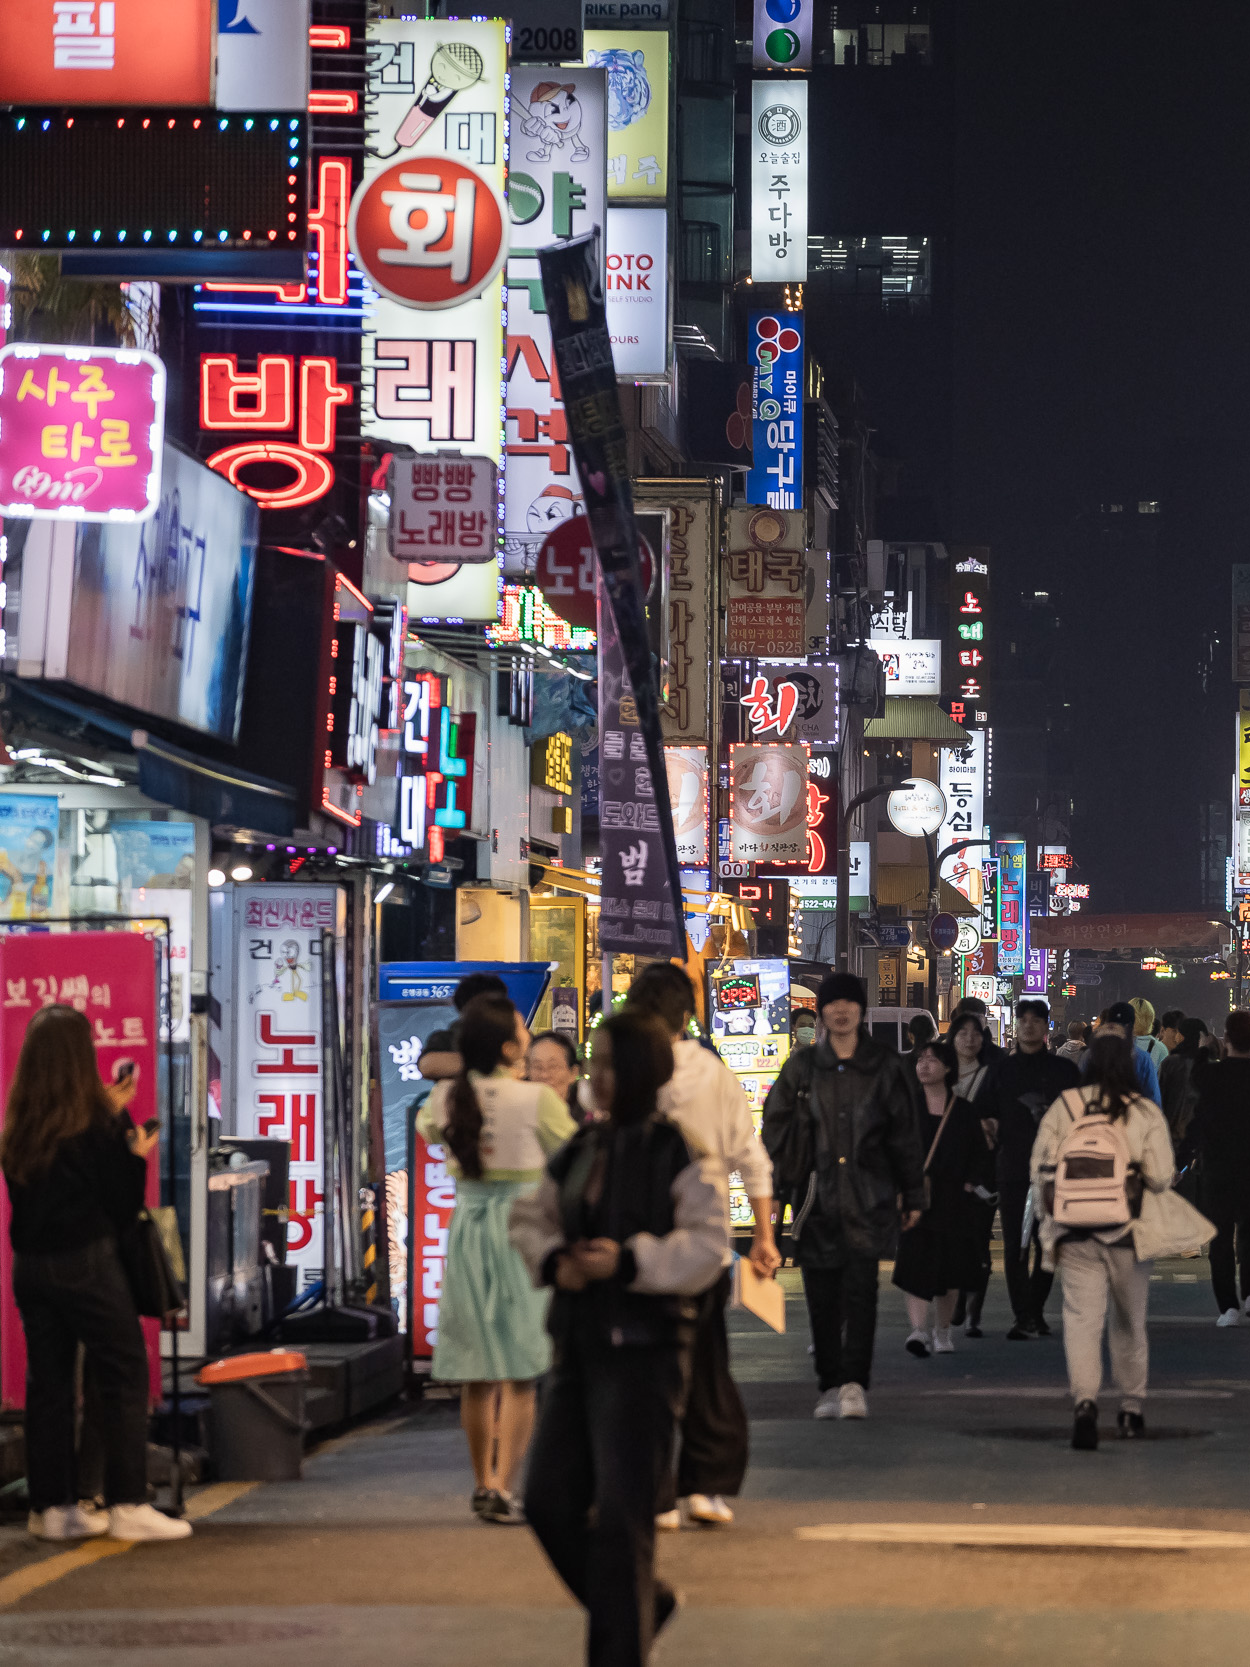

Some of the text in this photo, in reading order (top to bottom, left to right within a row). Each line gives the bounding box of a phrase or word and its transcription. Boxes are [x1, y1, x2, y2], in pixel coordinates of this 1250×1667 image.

[758, 152, 801, 165] 오늘술집
[377, 173, 476, 283] 회
[768, 174, 793, 258] 주다방
[17, 365, 115, 419] 사주
[759, 349, 773, 394] MY
[783, 369, 797, 414] 마이큐
[41, 419, 137, 467] 타로
[411, 462, 476, 502] 빵빵
[396, 509, 488, 547] 노래방
[729, 550, 805, 593] 태국
[730, 641, 803, 655] 467-0525
[808, 635, 825, 649] 3F
[957, 591, 984, 700] 노래타운
[740, 676, 799, 736] 회
[976, 711, 987, 721] B1
[738, 761, 801, 827] 회
[947, 782, 974, 832] 등심
[245, 899, 334, 930] 최신사운드
[1001, 873, 1020, 951] 노래방
[720, 986, 757, 1004] OPEN
[1027, 975, 1042, 987] B1
